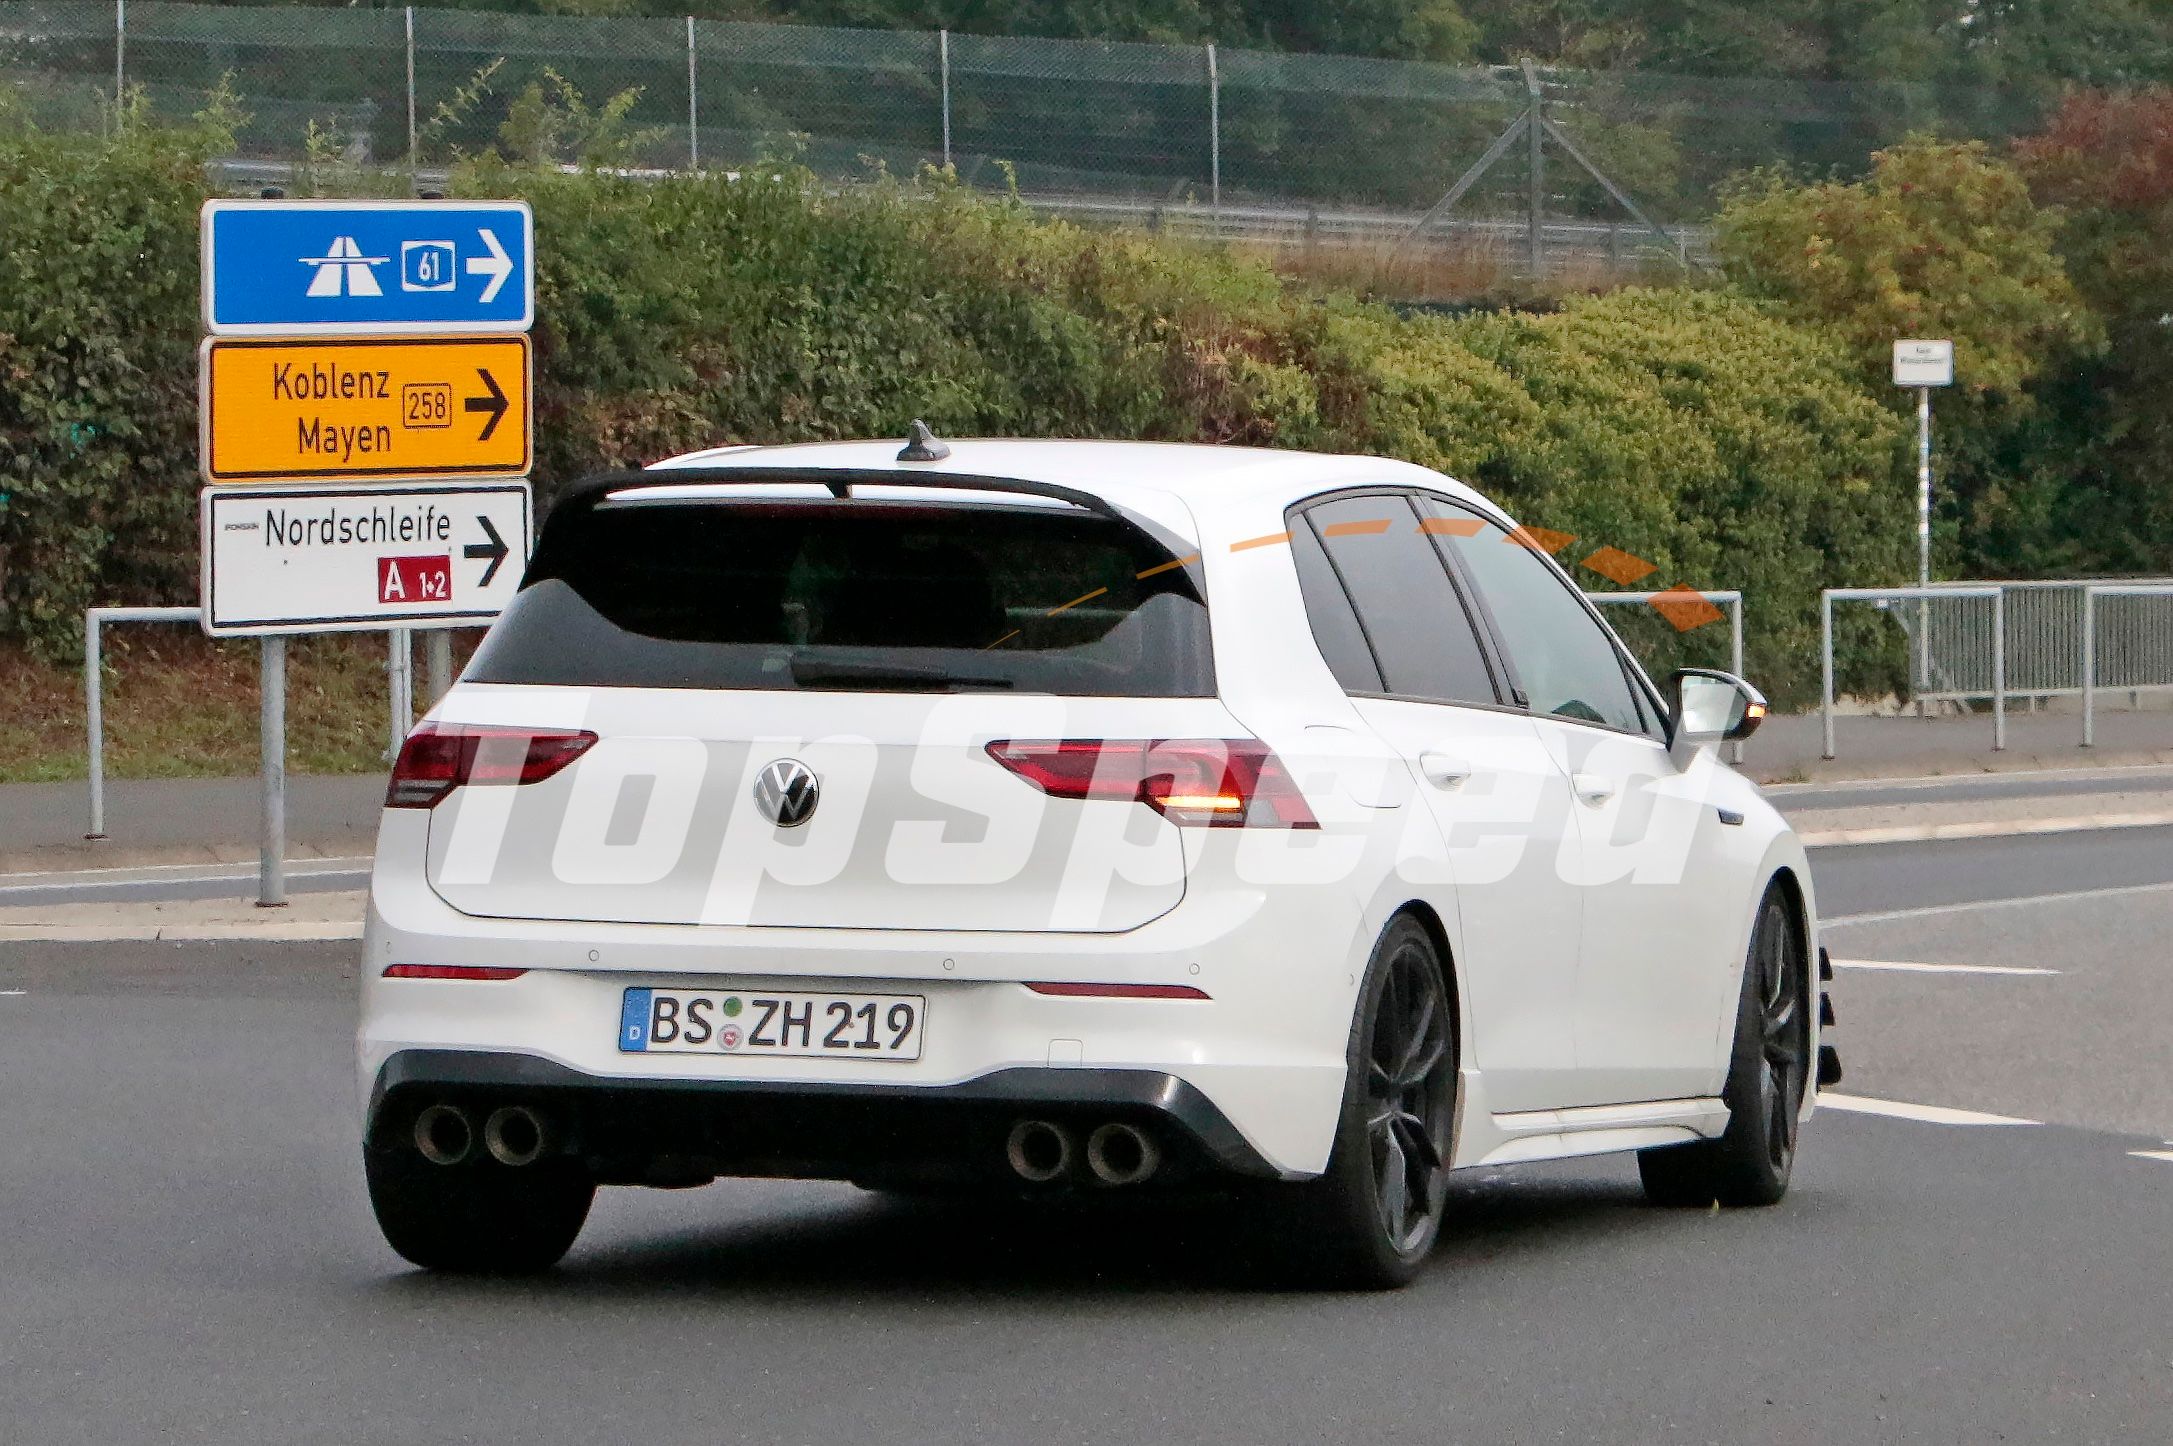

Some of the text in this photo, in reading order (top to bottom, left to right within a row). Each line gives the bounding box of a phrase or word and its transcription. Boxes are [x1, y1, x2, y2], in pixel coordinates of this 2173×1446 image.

[417, 250, 440, 281] 61
[273, 362, 390, 401] Koblenz
[407, 391, 447, 422] 258
[298, 416, 391, 463] Mayen
[265, 504, 451, 547] Nordschleife
[384, 560, 406, 600] A
[628, 1025, 641, 1041] D
[650, 996, 915, 1050] BS ZH 219
